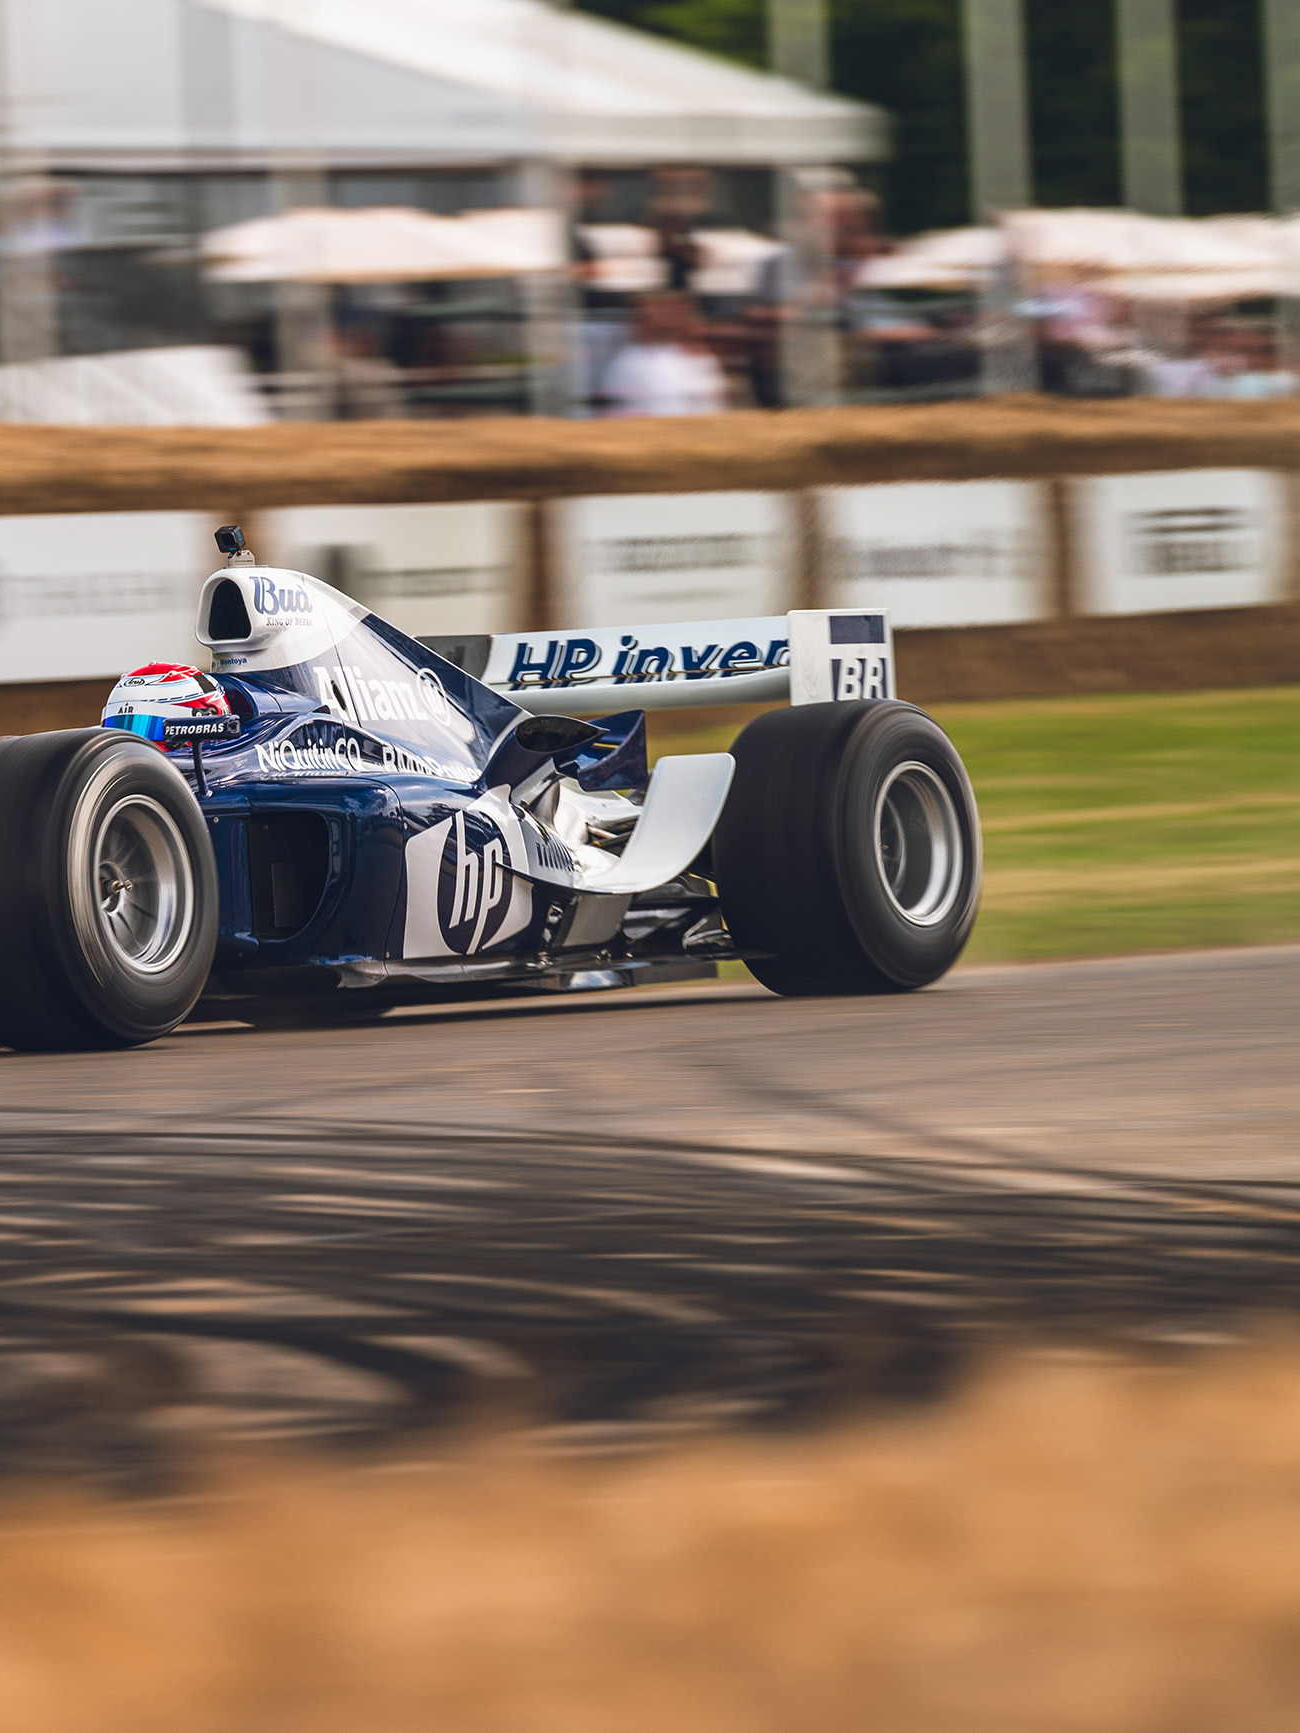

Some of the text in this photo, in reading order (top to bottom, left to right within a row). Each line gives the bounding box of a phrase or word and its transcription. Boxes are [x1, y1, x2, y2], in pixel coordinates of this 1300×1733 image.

[249, 576, 313, 615] Bud
[508, 635, 790, 691] HP inven
[313, 665, 429, 722] Allianz
[165, 723, 225, 736] PETROBRAS
[448, 809, 504, 955] hp
